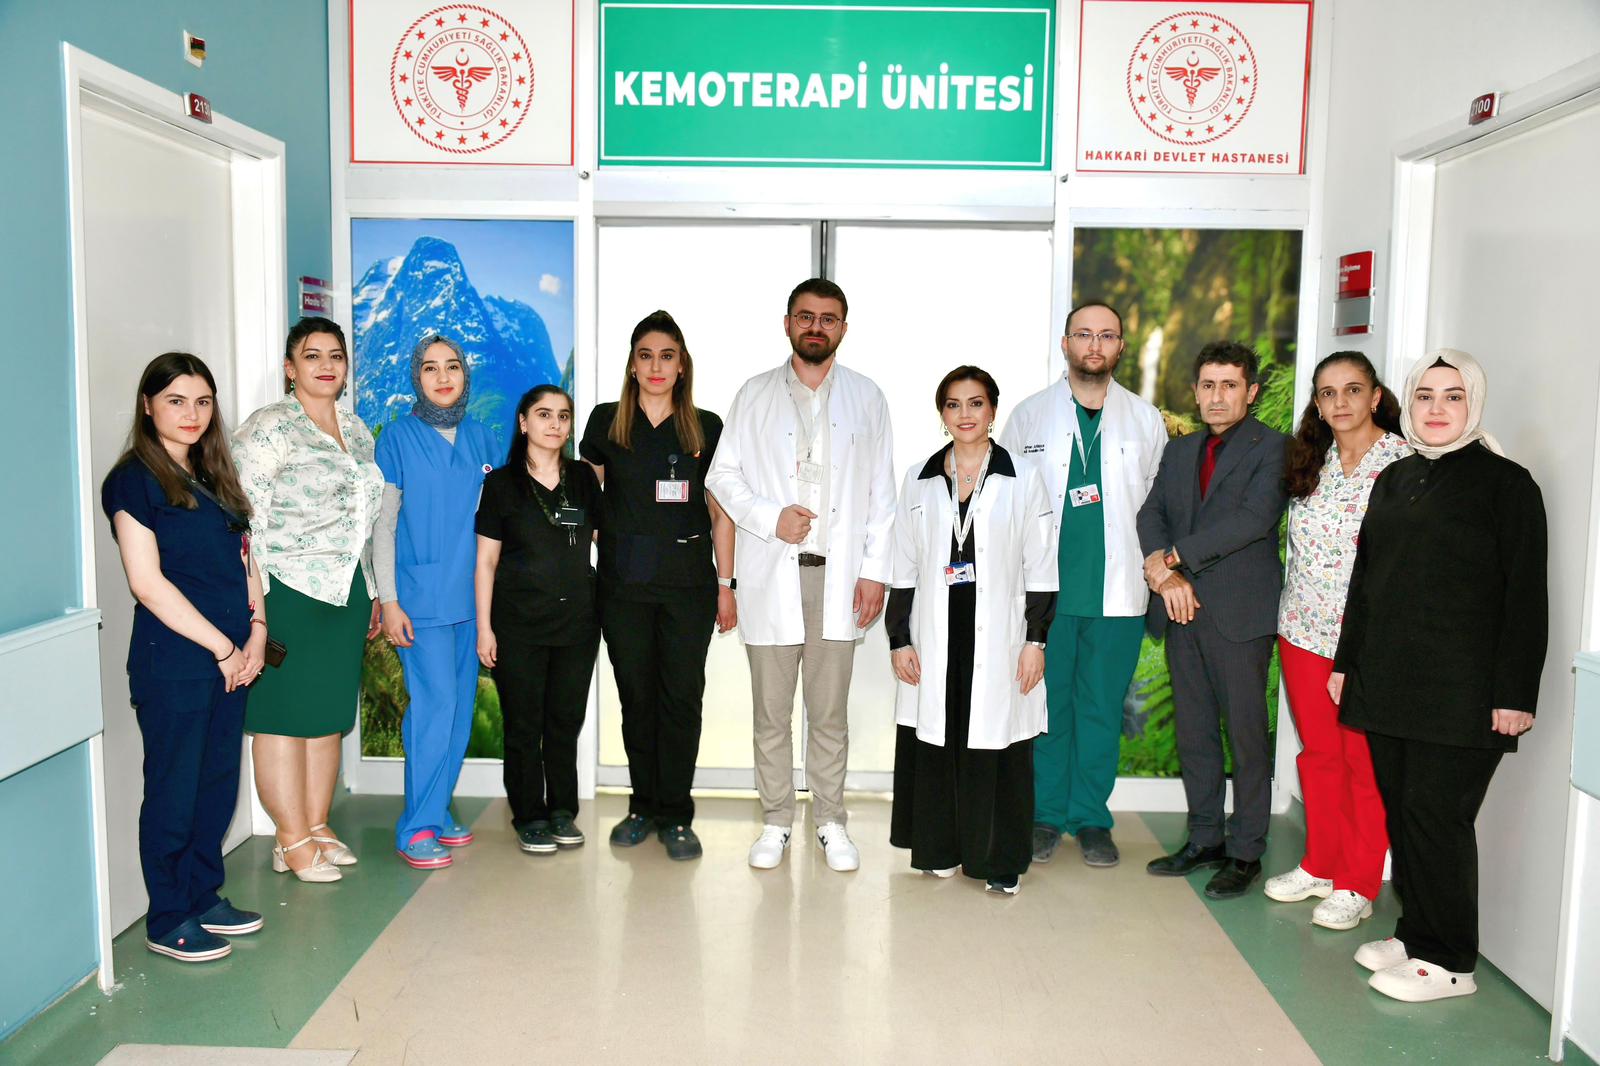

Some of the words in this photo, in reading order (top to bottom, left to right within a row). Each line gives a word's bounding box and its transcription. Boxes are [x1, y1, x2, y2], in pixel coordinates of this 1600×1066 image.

[614, 61, 868, 109] KEMOTERAPİ
[881, 62, 1034, 111] ÜNİTESİ
[1085, 149, 1147, 162] HAKKARİ
[1153, 151, 1206, 163] DEVLET
[1211, 151, 1289, 164] HASTANESİ
